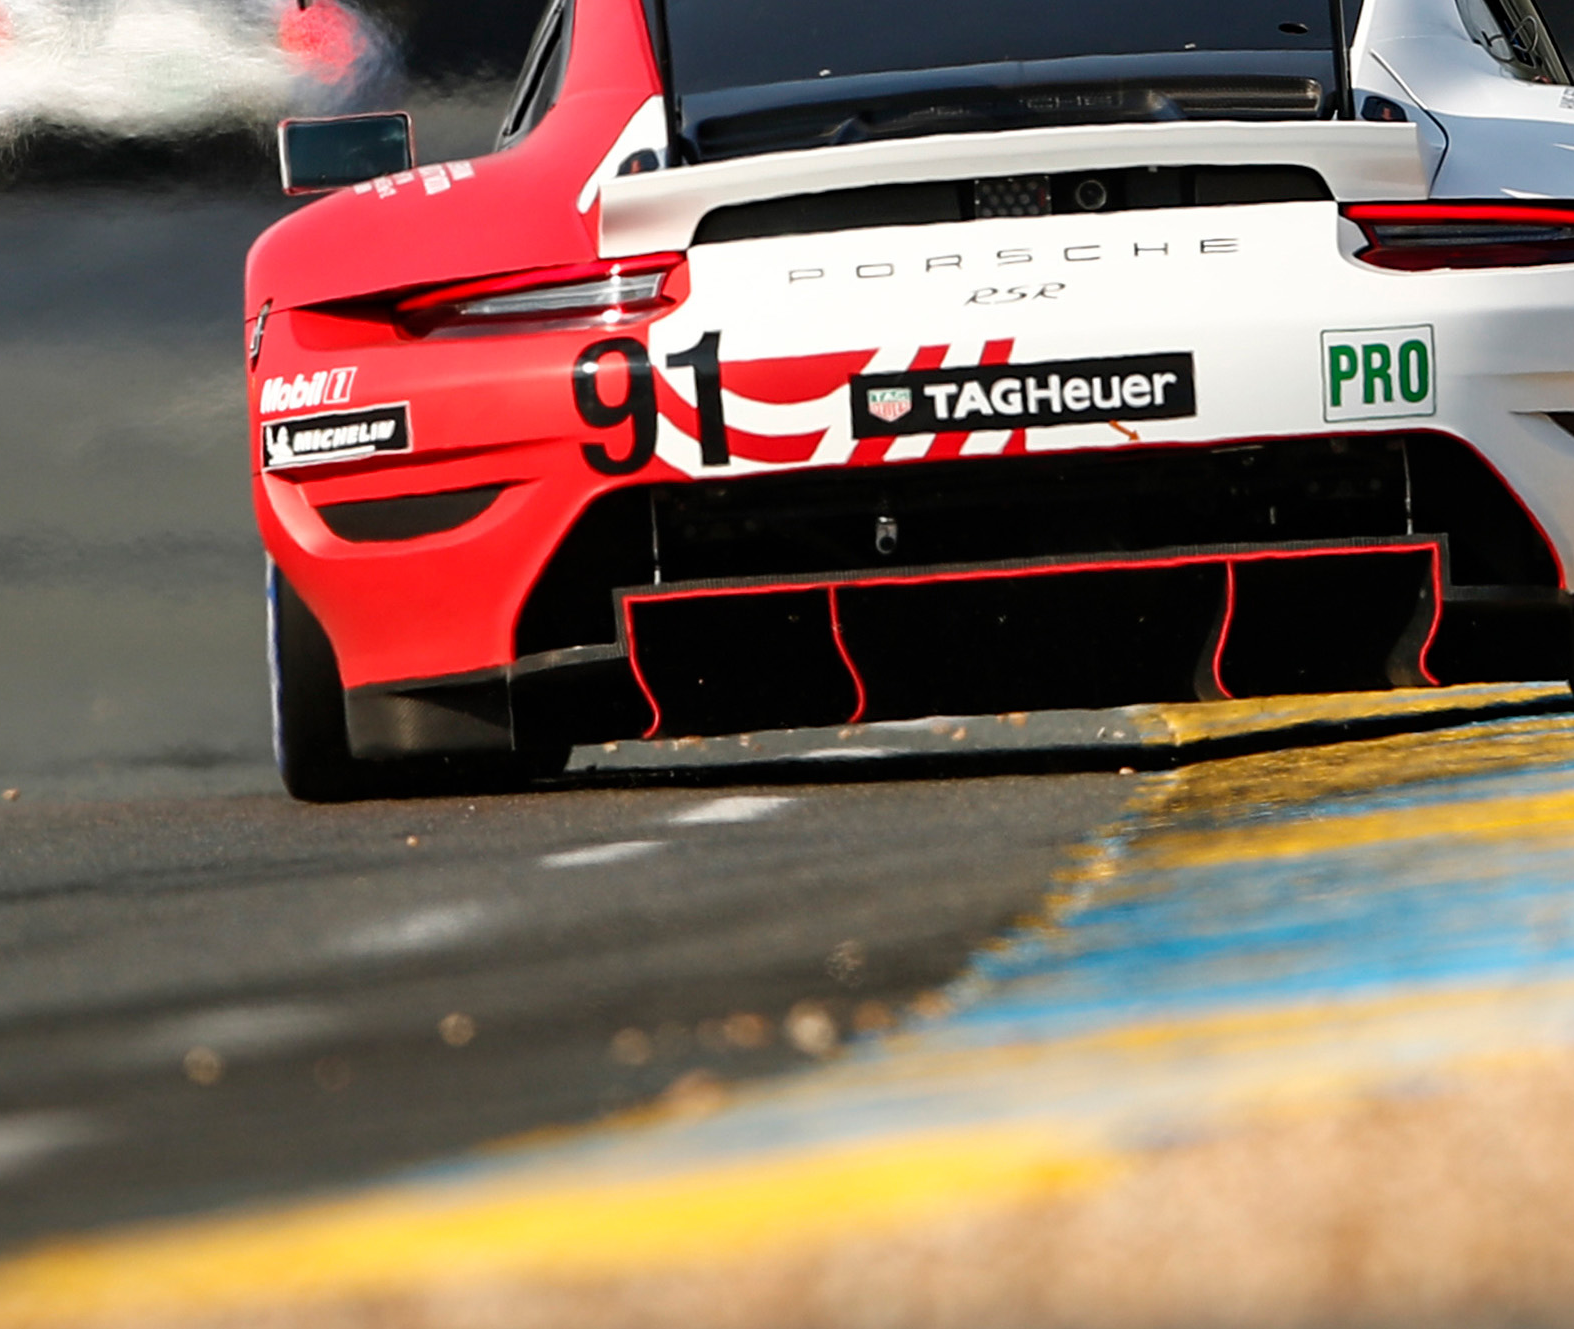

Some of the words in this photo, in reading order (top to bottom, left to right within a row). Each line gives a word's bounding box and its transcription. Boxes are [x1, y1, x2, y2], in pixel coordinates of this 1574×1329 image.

[788, 238, 1239, 284] PORSCHE
[964, 281, 1067, 306] RSR
[260, 371, 328, 414] Mobil
[1328, 339, 1429, 407] PRO
[572, 330, 730, 477] 91
[292, 420, 396, 453] MICHELIN
